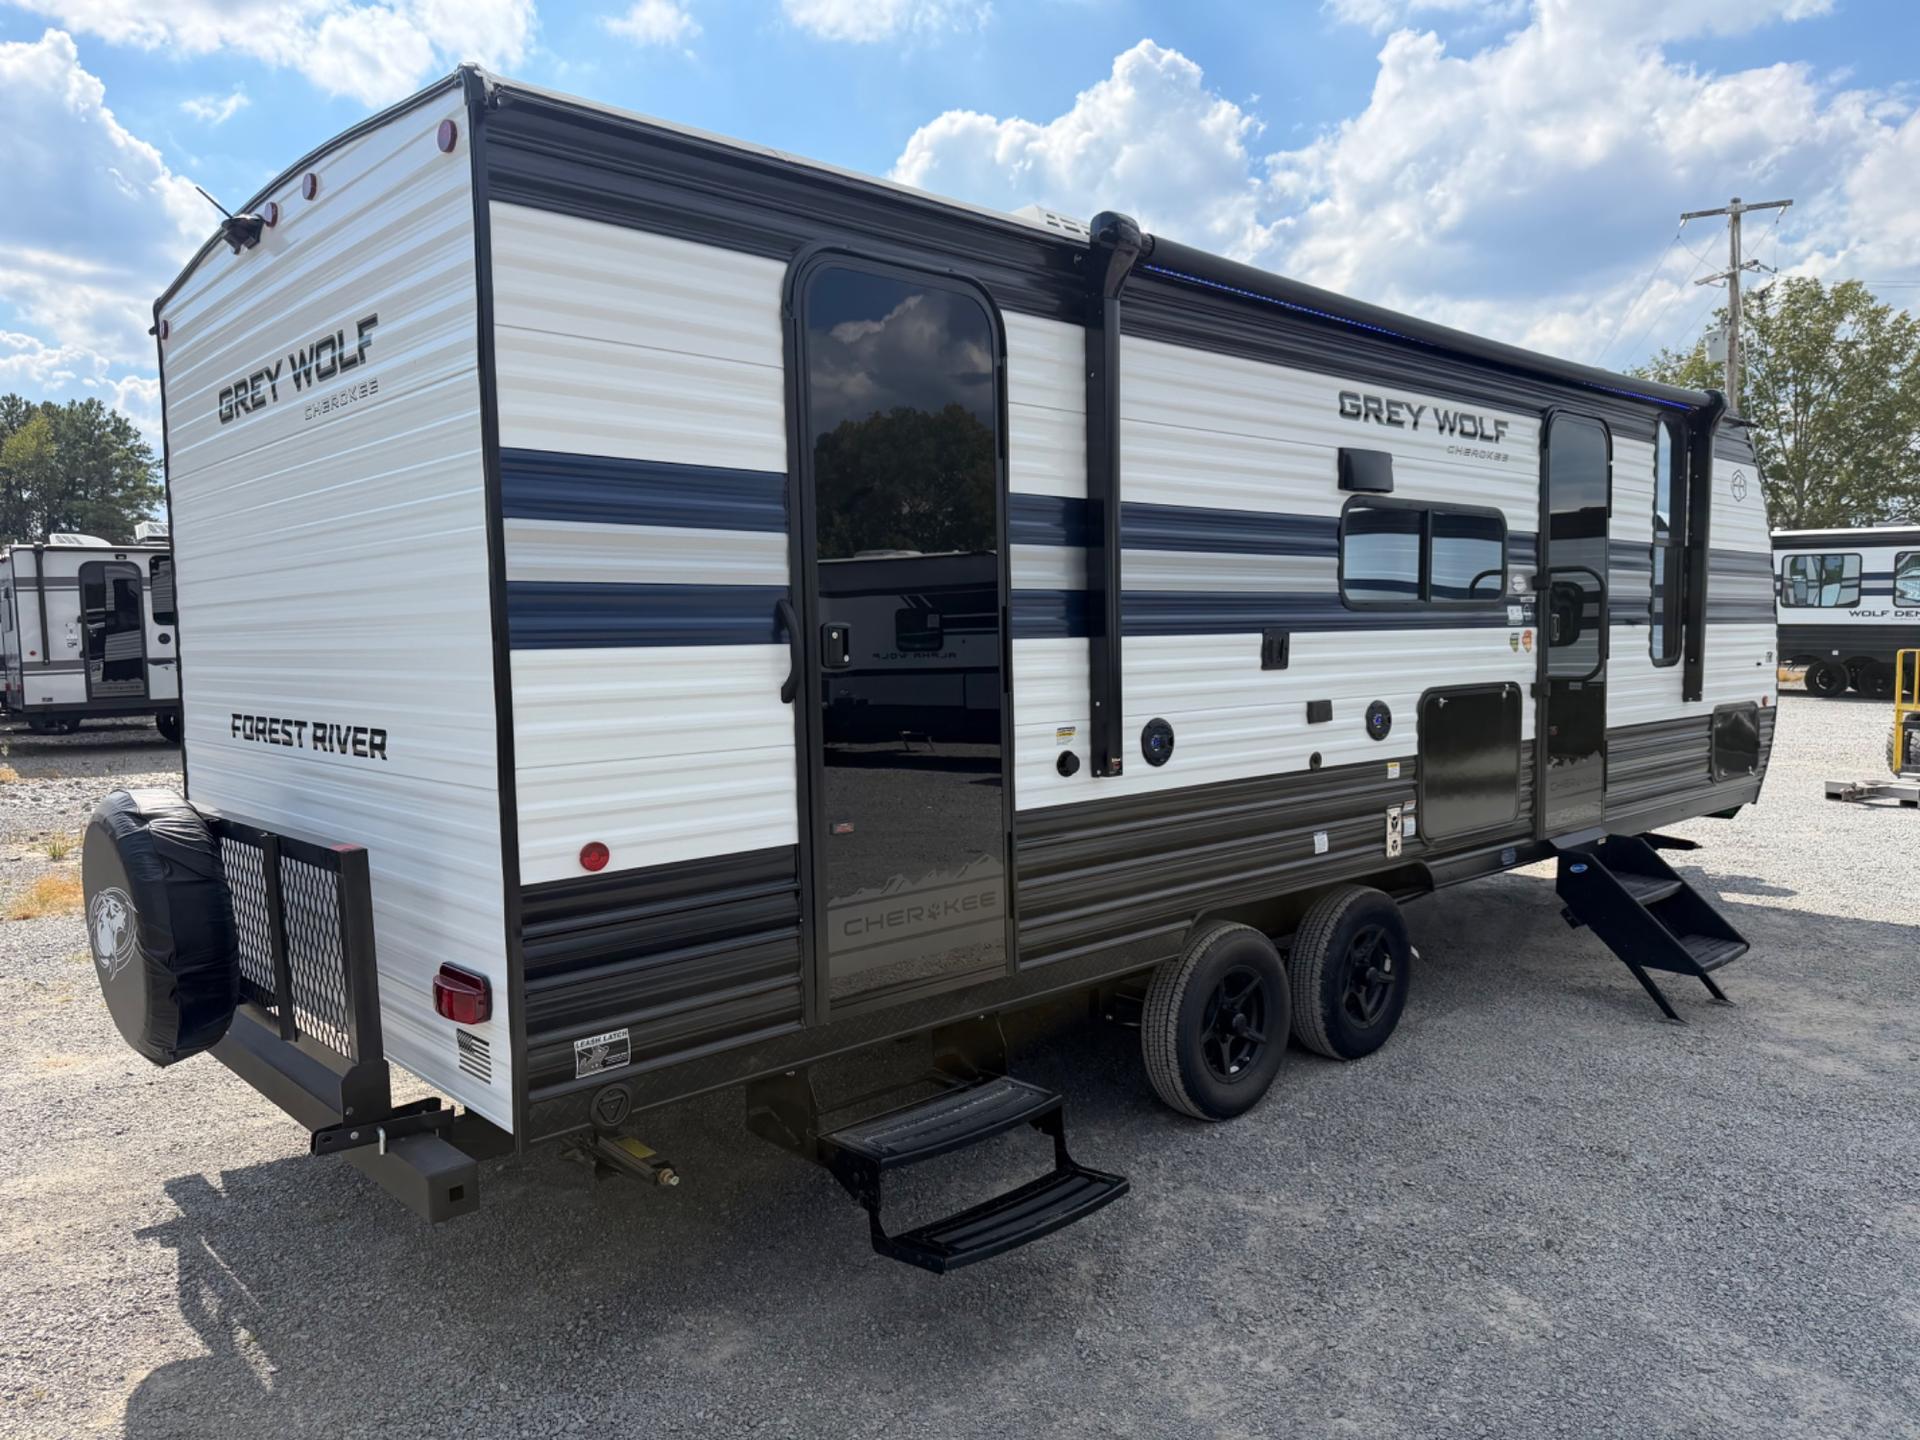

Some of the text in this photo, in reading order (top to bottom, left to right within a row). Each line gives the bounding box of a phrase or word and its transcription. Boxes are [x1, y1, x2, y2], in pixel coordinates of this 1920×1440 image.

[218, 313, 378, 425] GREY WOLF
[305, 377, 379, 421] CHEROKEE
[1338, 390, 1509, 444] GREY WOLF
[1446, 445, 1509, 462] CHEROKEE
[231, 713, 388, 761] FOREST RIVER
